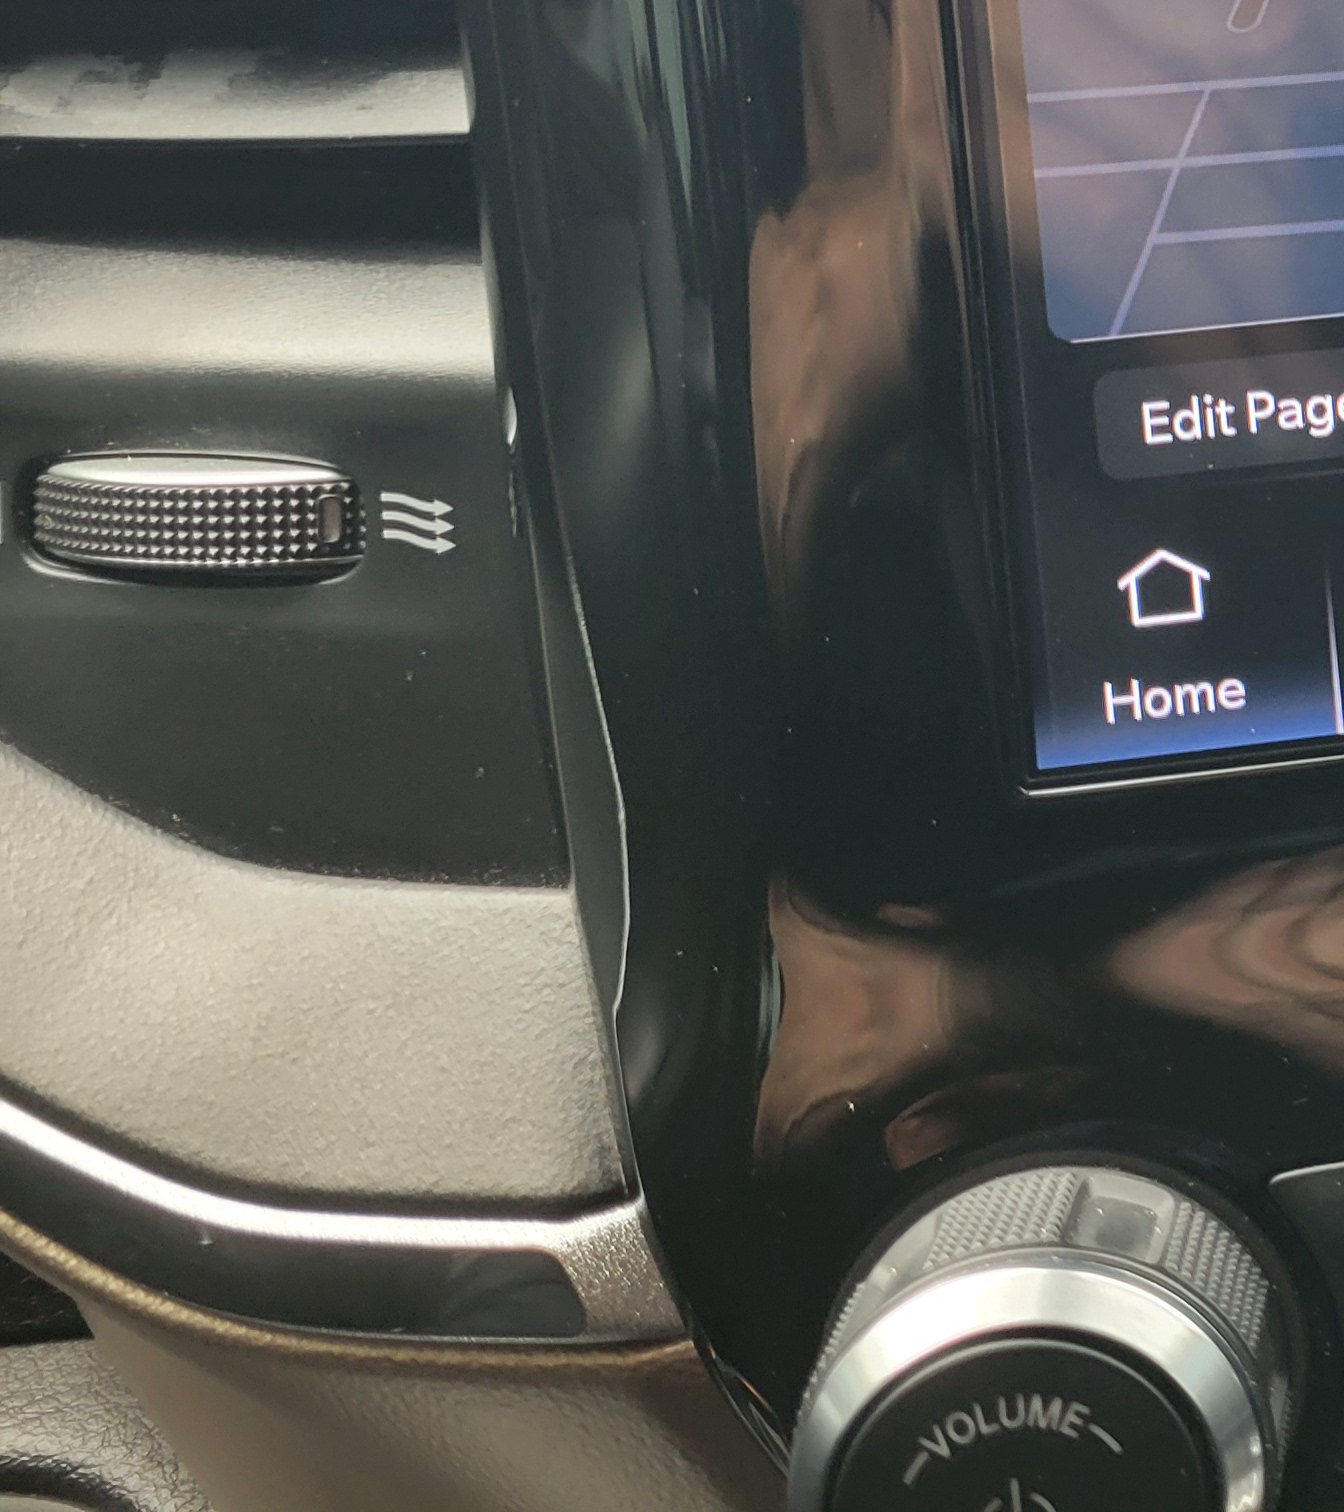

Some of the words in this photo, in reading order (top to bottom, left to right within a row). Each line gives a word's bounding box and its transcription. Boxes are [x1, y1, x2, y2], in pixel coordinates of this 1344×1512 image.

[1141, 395, 1235, 446] Edit
[1103, 677, 1247, 724] Home
[919, 1394, 1090, 1461] VOLUME
